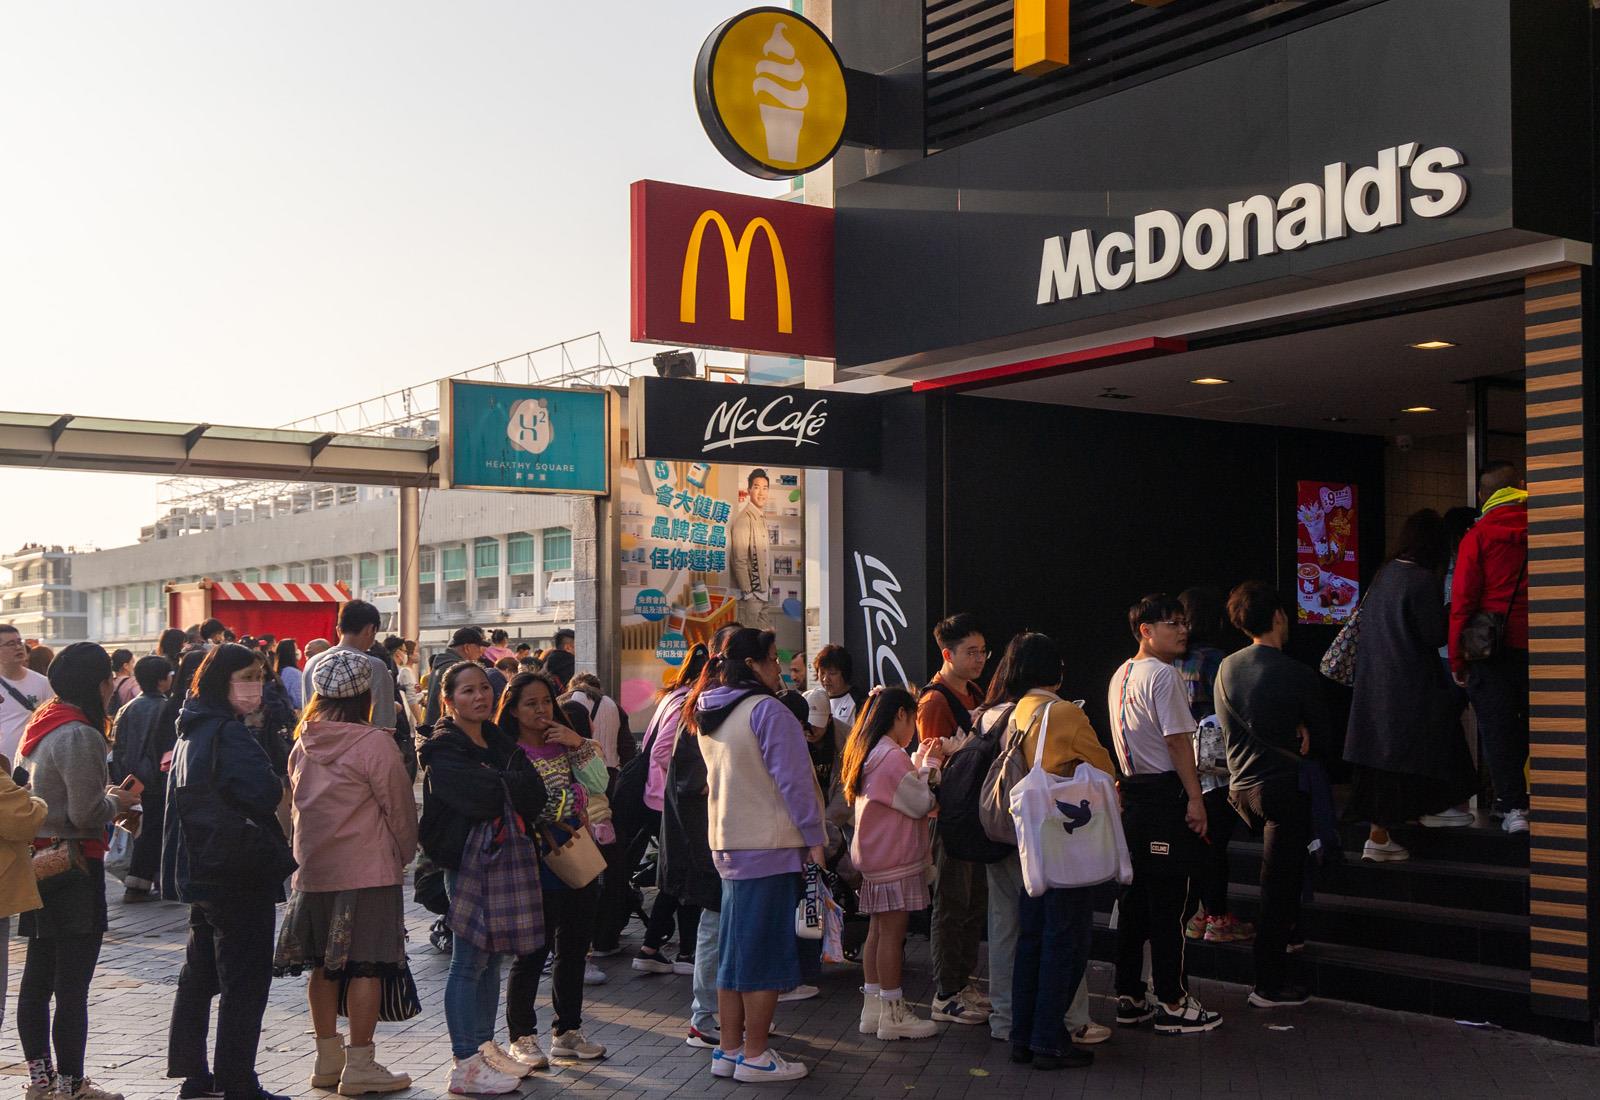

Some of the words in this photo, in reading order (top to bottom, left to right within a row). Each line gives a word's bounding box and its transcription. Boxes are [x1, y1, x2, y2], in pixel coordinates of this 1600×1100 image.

[1036, 142, 1467, 305] McDonald's
[702, 395, 827, 450] McCafé
[486, 460, 531, 470] HEALTHY
[535, 463, 575, 472] SQUARE
[656, 484, 731, 523] 各大健康
[651, 516, 727, 548] 品牌產品
[650, 547, 726, 572] 任你選擇
